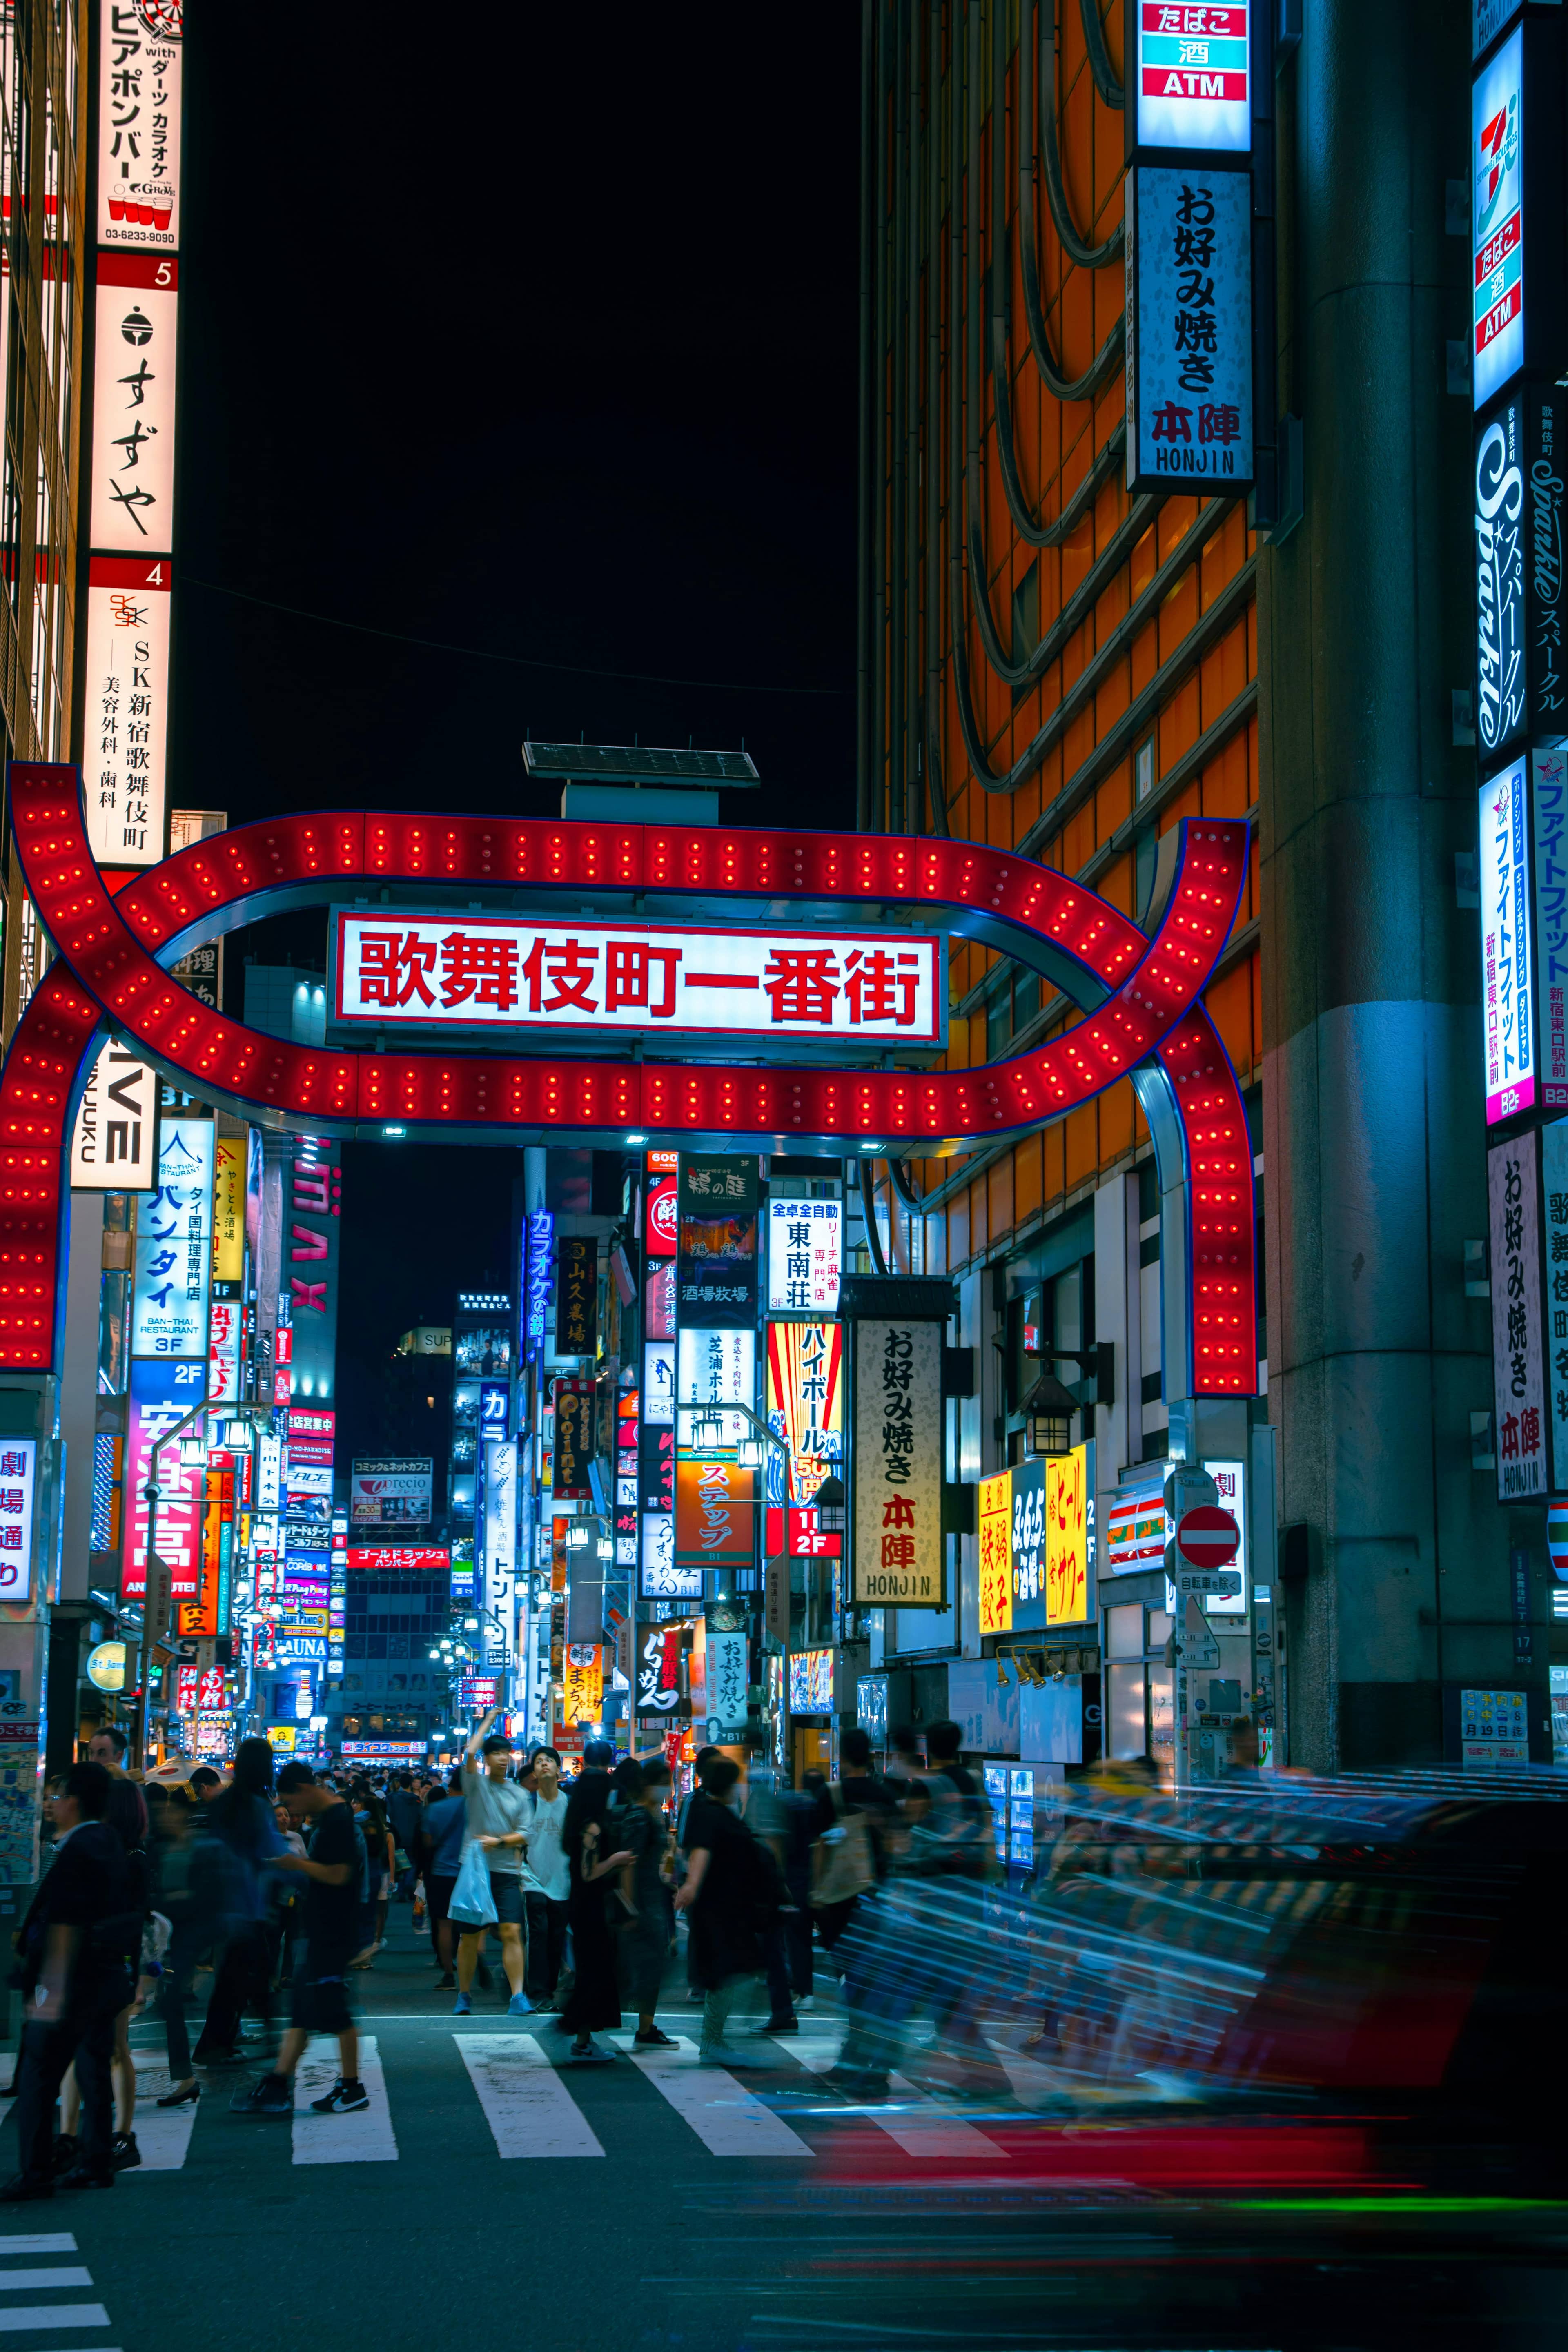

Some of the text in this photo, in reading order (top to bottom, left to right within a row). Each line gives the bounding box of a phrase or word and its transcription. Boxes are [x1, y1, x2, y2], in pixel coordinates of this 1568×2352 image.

[1158, 6, 1231, 33] たばこ
[145, 47, 176, 58] with
[1178, 40, 1209, 64] 酒
[109, 5, 142, 179] ビアポンバー
[1163, 72, 1225, 97] ATM
[151, 60, 169, 178] ダーツ カラオケ
[1495, 131, 1518, 162] HOLDINGS
[142, 183, 175, 196] GROVE
[106, 229, 174, 243] 03-6233-9090
[1481, 223, 1514, 278] たばこ
[155, 263, 172, 285] 5
[1173, 185, 1218, 392] お好み焼き
[1491, 265, 1505, 302] 酒
[1484, 294, 1512, 343] ATM
[109, 358, 158, 535] すずや
[1152, 401, 1241, 445] 本陣
[1541, 406, 1553, 456] 歌舞伎町
[1156, 448, 1234, 474] HONJIN
[1530, 459, 1564, 604] Sparkle
[145, 562, 163, 586] 4
[1475, 423, 1522, 748] Sparkle
[1500, 526, 1525, 742] スパークル
[1535, 610, 1565, 712] スパークル
[99, 676, 120, 808] 美容外科・歯科
[123, 641, 152, 851] SK新宿歌舞伎町
[1537, 785, 1568, 982] ファイトフィット
[1515, 872, 1526, 984] キックボクシング
[358, 932, 920, 1026] 歌舞伎町一番街
[1495, 829, 1515, 1080] ファイトフィット
[1486, 932, 1499, 1086] 新宿東口駅前
[1519, 996, 1527, 1060] ダイエット
[1549, 987, 1566, 1078] 新宿東口駅前
[81, 1062, 98, 1163] NJUKU
[106, 1038, 144, 1164] IVE
[1501, 1089, 1520, 1116] B2F
[160, 1165, 200, 1177] STAURANT
[649, 1178, 661, 1186] 4F
[223, 1170, 236, 1241] やきとん酒場
[773, 1203, 838, 1218] 全卓全自動
[147, 1185, 183, 1309] バンタイ
[186, 1187, 203, 1301] タイ国料理専門店
[648, 1261, 662, 1271] 3F
[786, 1222, 811, 1308] 東南荘
[827, 1222, 838, 1291] リーチ麻雀
[213, 1282, 230, 1296] 1F
[682, 1285, 749, 1302] 酒場牧場
[815, 1249, 825, 1301] 専門店
[1504, 1160, 1528, 1398] お好み焼き
[568, 1263, 585, 1342] 山久農場
[771, 1298, 784, 1307] 3F
[155, 1338, 183, 1352] 3F
[425, 1335, 451, 1347] SUP
[174, 1365, 203, 1384] 2F
[563, 1381, 588, 1390] 麻雀
[800, 1328, 828, 1454] ハイボール
[882, 1328, 914, 1485] お好み焼き
[559, 1394, 579, 1484] Point
[1501, 1407, 1541, 1461] 本陣
[135, 1400, 195, 1567] 安楽亭
[355, 1462, 430, 1472] コミック&ネットカフェ
[802, 1478, 821, 1499] 円
[1504, 1461, 1538, 1495] HONJIN
[0, 1451, 26, 1586] 劇場通り
[562, 1489, 586, 1498] 4F
[697, 1464, 733, 1549] ステップ
[1058, 1457, 1083, 1532] ビール
[797, 1536, 826, 1553] 2F
[799, 1511, 817, 1530] 1
[881, 1493, 916, 1569] 本陣
[981, 1519, 1007, 1571] 鉄鍋
[1087, 1499, 1096, 1563] 2F
[359, 1549, 445, 1560] ゴールドラッシュ
[375, 1559, 417, 1567] ハンバーグ
[645, 1566, 655, 1595] 一番街
[1019, 1550, 1038, 1601] 酒場
[680, 1586, 699, 1595] B1F
[866, 1575, 931, 1596] HONJIN
[982, 1574, 1007, 1628] 餃子
[1058, 1546, 1085, 1617] サワー
[1181, 1576, 1236, 1590] 自転車を除く
[1517, 1637, 1530, 1648] 17
[462, 1681, 496, 1693] 24時間
[463, 1694, 495, 1704] 営業中
[569, 1668, 585, 1722] まっちゃん
[719, 1640, 744, 1718] お好み焼き
